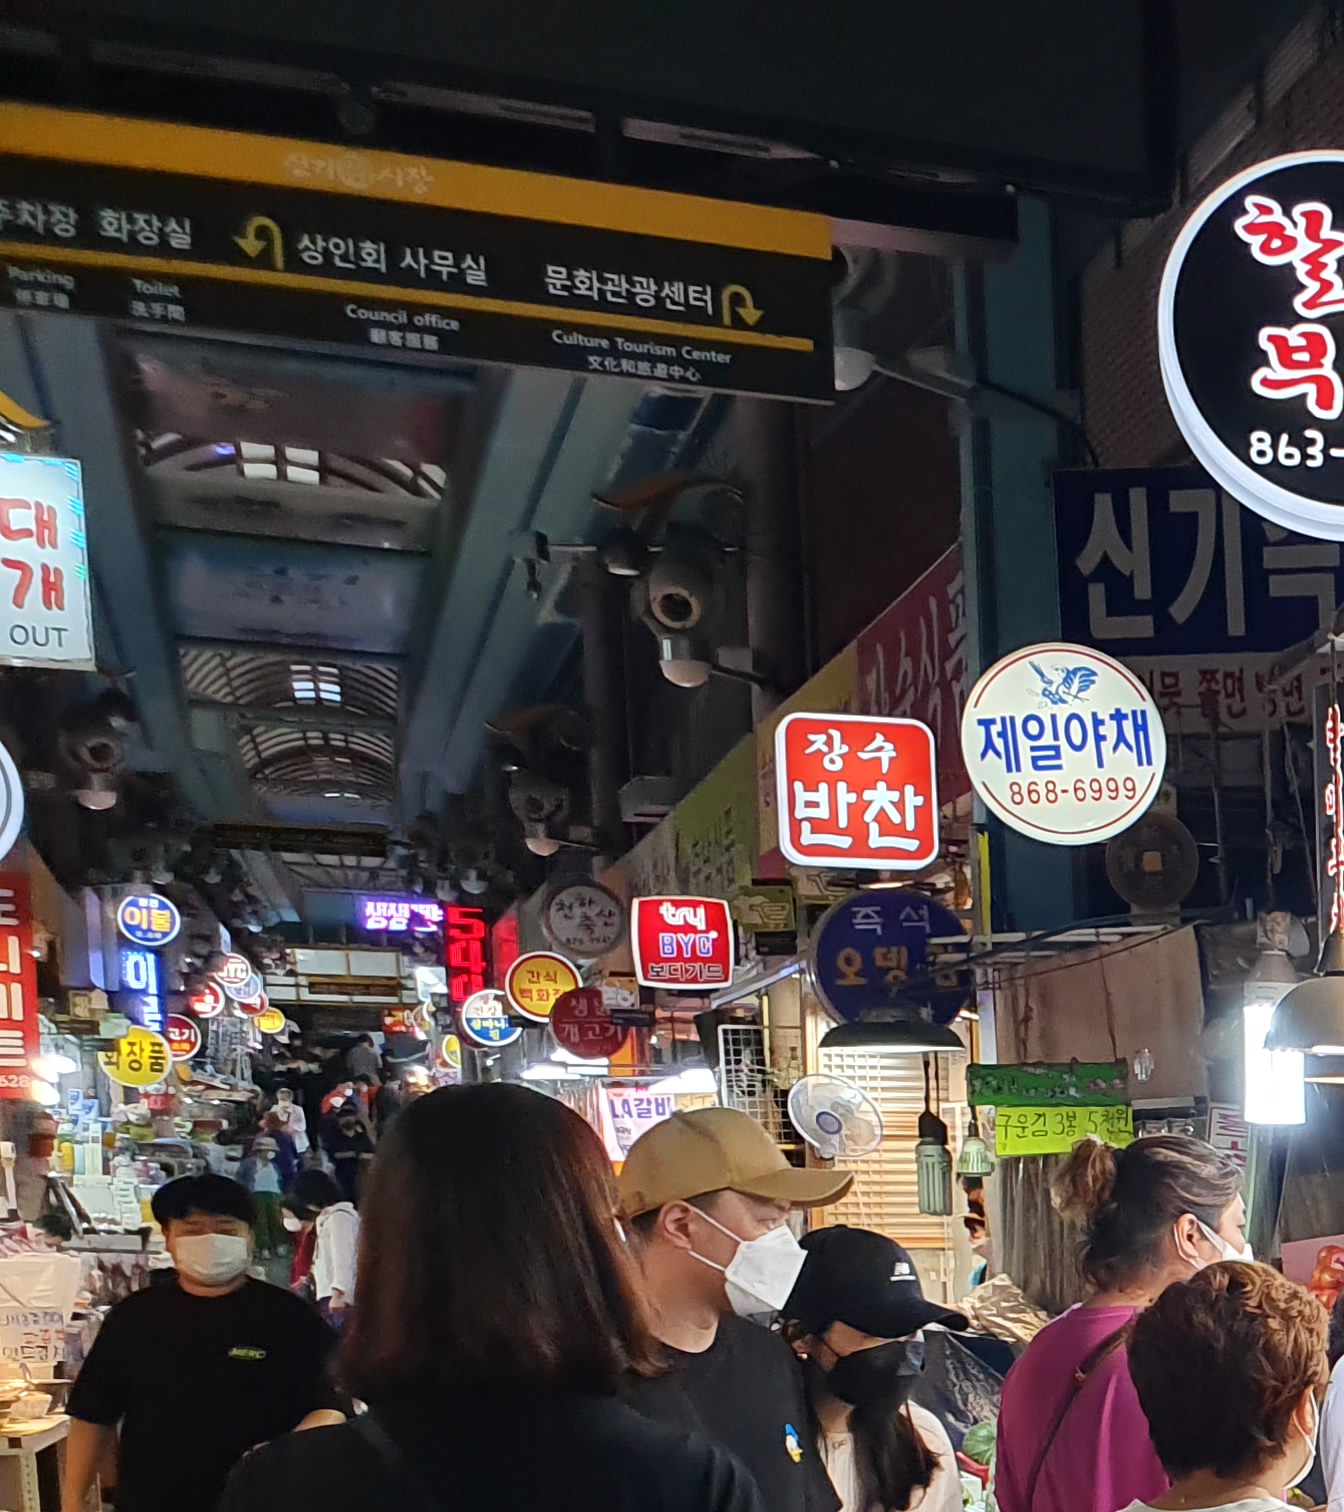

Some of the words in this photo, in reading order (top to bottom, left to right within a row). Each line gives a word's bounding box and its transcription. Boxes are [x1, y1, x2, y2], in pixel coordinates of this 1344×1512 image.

[98, 207, 193, 251] 화장실
[296, 231, 388, 274] 상인회
[400, 247, 488, 287] 사무실
[543, 262, 713, 316] 문화관광센터
[346, 303, 408, 326] Council
[413, 311, 461, 332] office
[551, 329, 610, 351] Culture
[614, 335, 677, 359] Tourism
[681, 345, 733, 366] Center
[10, 626, 69, 648] OUT
[803, 728, 898, 774] 장수
[975, 707, 1155, 774] 제일야채
[1009, 776, 1138, 806] 868-6999
[792, 780, 925, 852] 반찬
[659, 901, 707, 931] try
[851, 905, 931, 934] 즉석
[659, 932, 714, 958] BYC
[526, 969, 559, 985] 간식
[648, 962, 725, 982] 보디가드
[995, 1110, 1049, 1141] 구운김
[1052, 1111, 1078, 1137] 3봉
